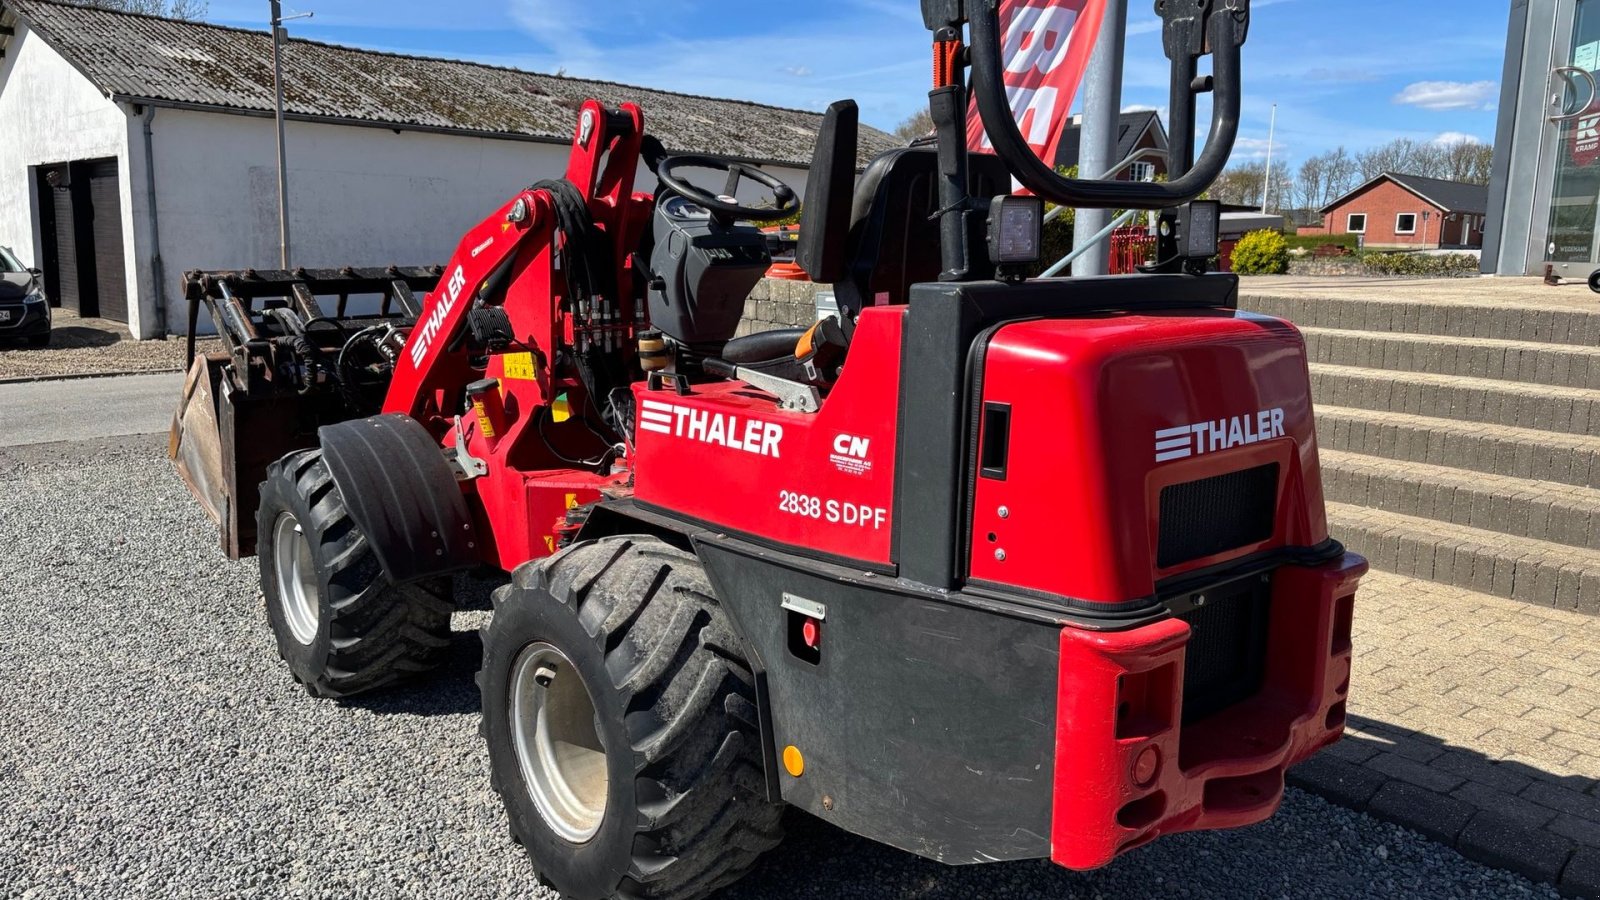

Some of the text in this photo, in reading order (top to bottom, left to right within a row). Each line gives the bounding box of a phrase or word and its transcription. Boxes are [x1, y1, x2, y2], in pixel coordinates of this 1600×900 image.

[1575, 142, 1599, 153] KRAMP
[833, 433, 870, 458] CN
[779, 489, 821, 519] 2838
